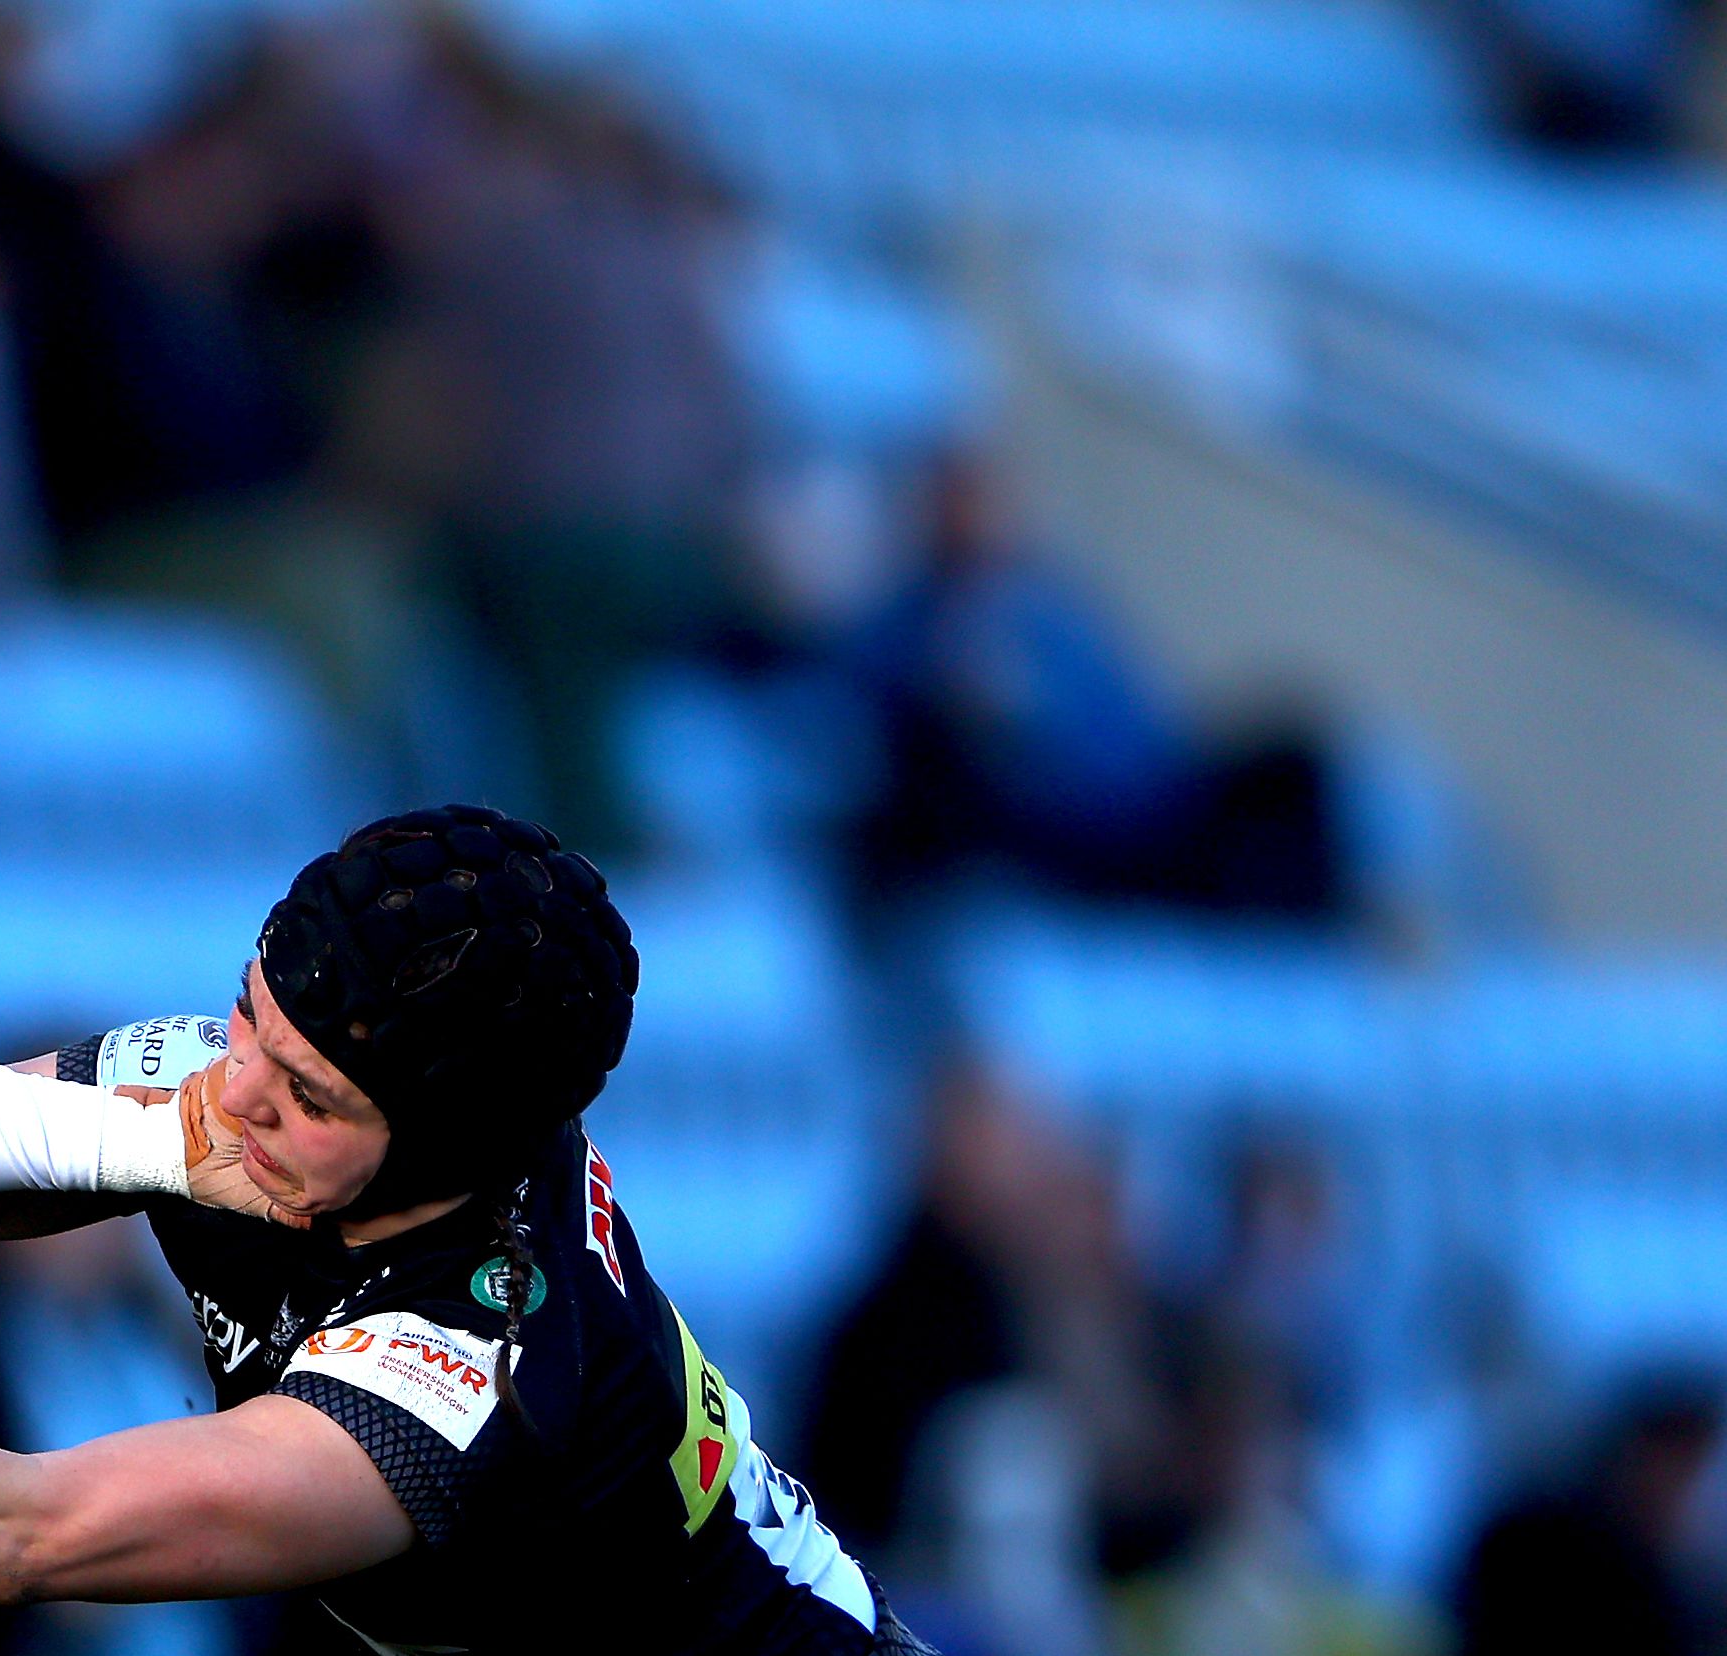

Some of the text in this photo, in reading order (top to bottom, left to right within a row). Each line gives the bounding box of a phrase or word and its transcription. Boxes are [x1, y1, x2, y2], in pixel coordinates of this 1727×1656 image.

[140, 1016, 173, 1077] NARD
[388, 1338, 489, 1396] PWR
[400, 1332, 451, 1349] Allianz
[377, 1361, 470, 1416] WOMEN'S RUGBY
[380, 1354, 456, 1395] PREMIERSHIP
